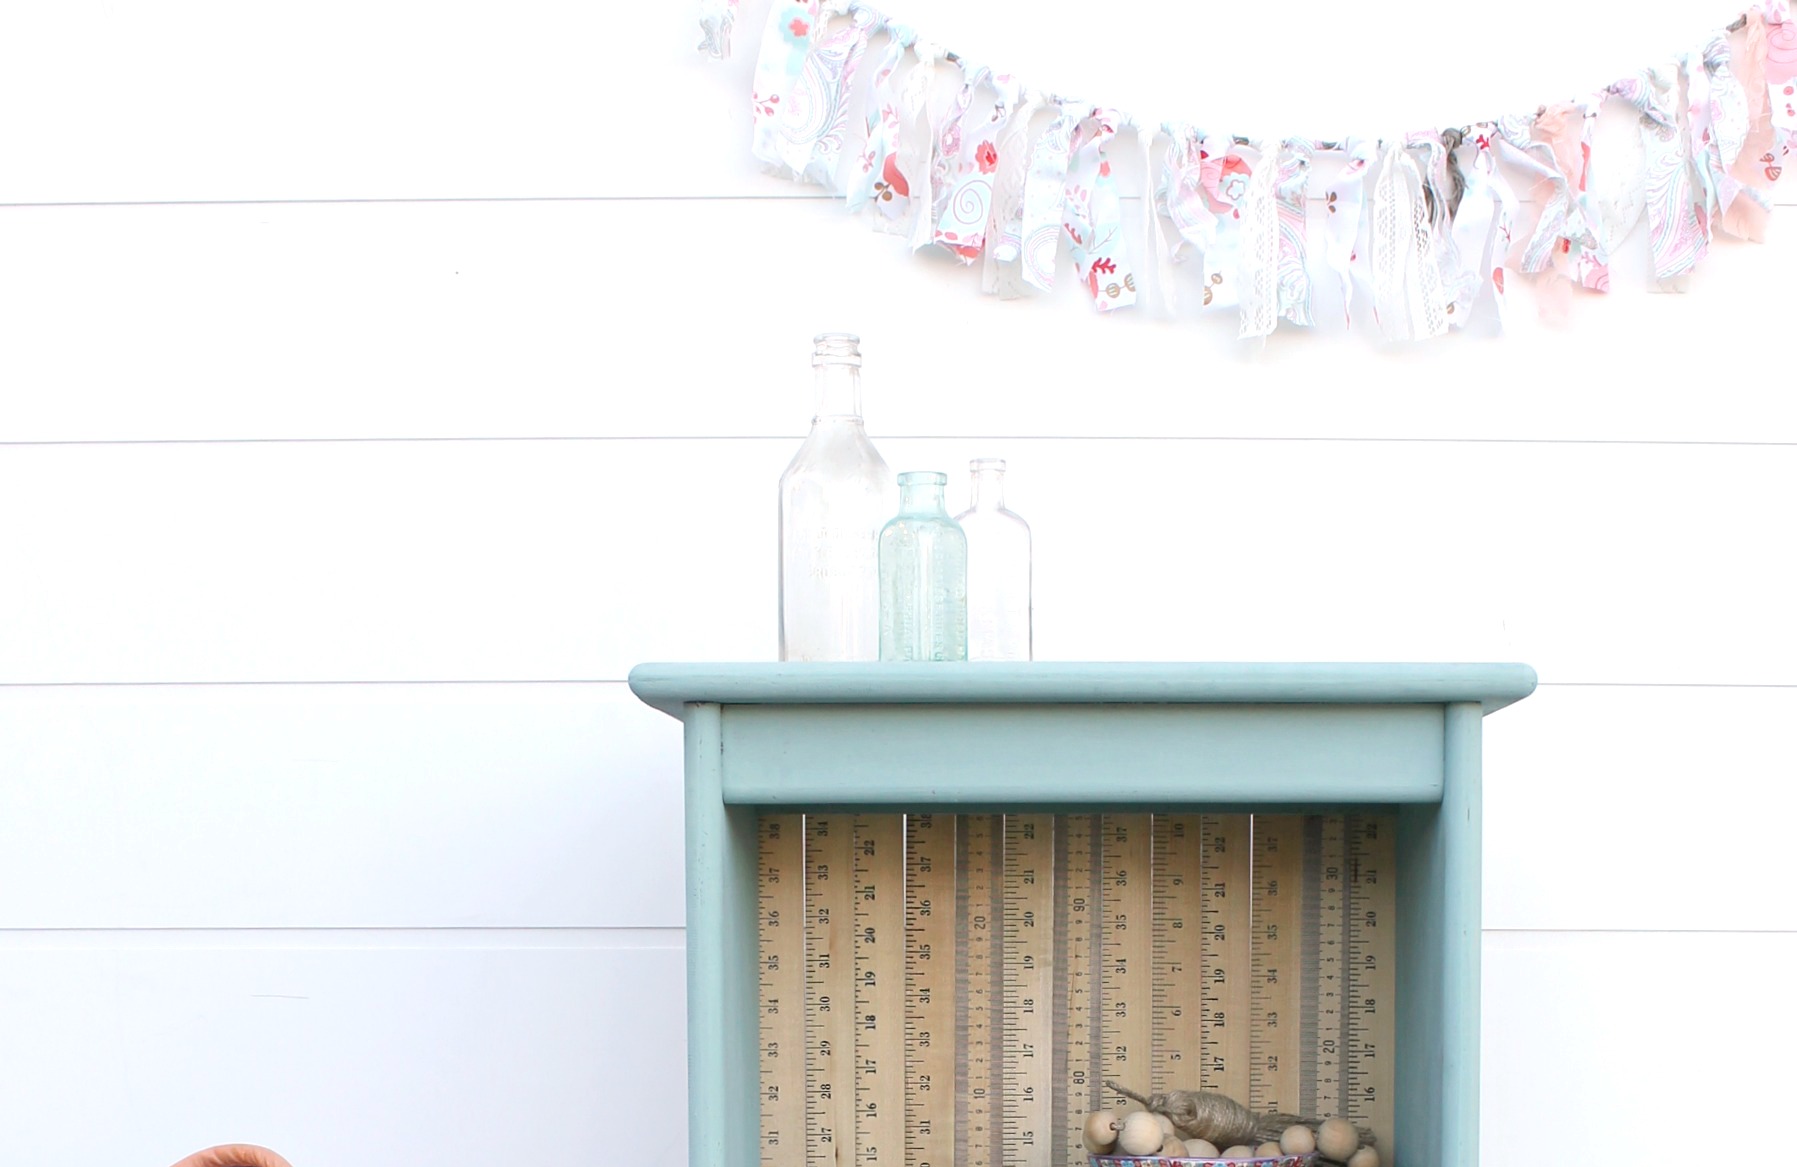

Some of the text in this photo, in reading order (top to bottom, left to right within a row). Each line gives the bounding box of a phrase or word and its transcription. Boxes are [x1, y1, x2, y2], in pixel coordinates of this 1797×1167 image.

[817, 821, 828, 836] 34
[1023, 823, 1035, 839] 22
[864, 840, 875, 856] 22
[921, 857, 932, 872] 37
[818, 865, 829, 880] 33
[1023, 869, 1035, 884] 21
[864, 885, 876, 900] 21
[921, 900, 932, 916] 36
[770, 911, 781, 926] 36
[818, 909, 829, 924] 32
[1023, 912, 1035, 927] 20
[864, 928, 876, 943] 20
[1116, 827, 1128, 1061] 32 33 34 35 36 37
[921, 944, 931, 960] 35
[769, 955, 780, 970] 35
[819, 954, 830, 968] 31
[1023, 956, 1035, 969] 19
[1324, 867, 1338, 1053] 20 30
[1171, 877, 1184, 1060] 5 6 7 8 9
[865, 972, 876, 986] 19
[1214, 883, 1225, 1071] 17 18 19 20 21
[920, 988, 931, 1003] 34
[1073, 898, 1085, 1084] 80 90
[769, 999, 780, 1013] 34
[819, 997, 831, 1011] 30
[974, 916, 985, 1100] 10 20
[1023, 999, 1034, 1013] 18
[865, 1015, 877, 1029] 18
[920, 1032, 931, 1047] 33
[820, 1041, 831, 1055] 29
[1023, 1044, 1034, 1057] 17
[1364, 999, 1376, 1101] 16 17 18
[865, 1060, 877, 1073] 17
[920, 1076, 931, 1090] 32
[820, 1084, 832, 1099] 28
[1022, 1087, 1034, 1101] 16
[866, 1103, 877, 1117] 16
[920, 1120, 931, 1134] 31
[769, 1131, 780, 1145] 31
[821, 1128, 832, 1142] 27
[1022, 1131, 1034, 1145] 15
[866, 1147, 878, 1160] 15
